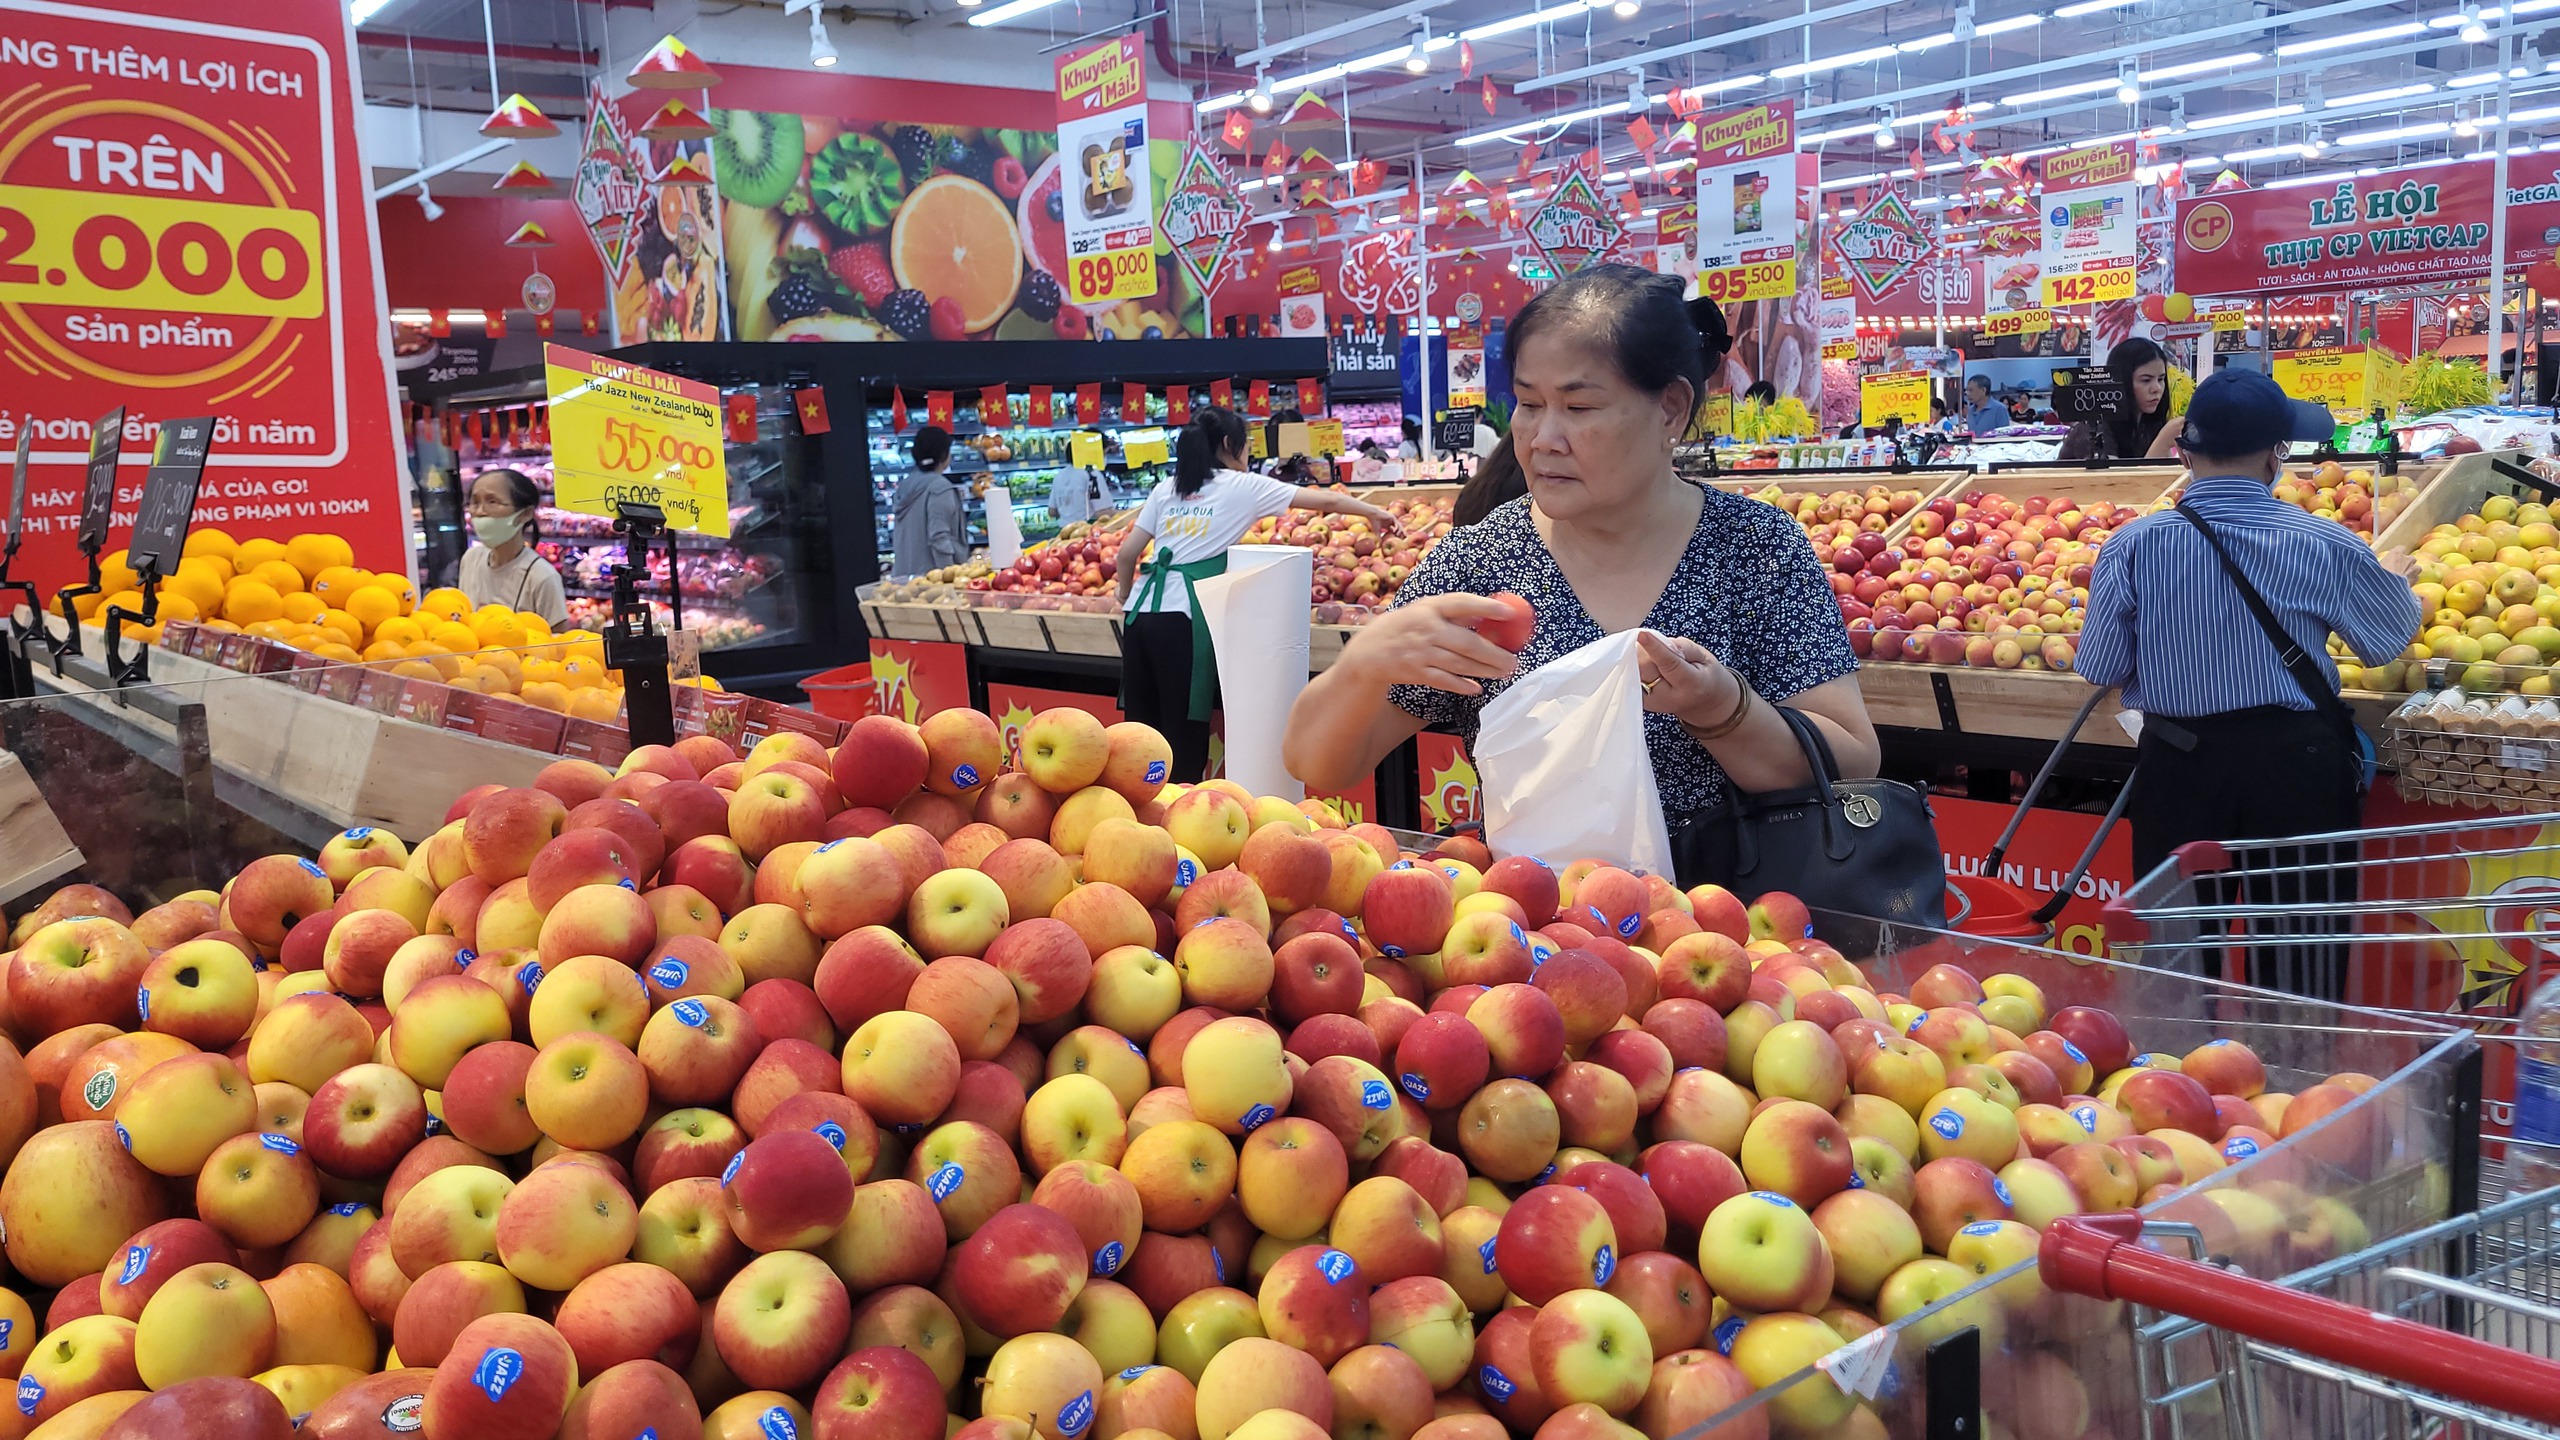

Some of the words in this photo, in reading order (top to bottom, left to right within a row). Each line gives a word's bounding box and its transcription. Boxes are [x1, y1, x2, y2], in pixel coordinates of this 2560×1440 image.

[0, 36, 58, 68] NG
[67, 44, 169, 82] THÊM
[179, 59, 236, 93] LỢI
[246, 61, 303, 98] ÍCH
[1064, 51, 1118, 92] Khuyến
[1705, 112, 1764, 144] Khuyến
[52, 134, 225, 195] TRÊN
[2050, 148, 2108, 175] Khuyến
[2310, 184, 2356, 227] LỄ
[2366, 181, 2440, 225] HỘI
[2506, 185, 2560, 204] ietGA
[1560, 216, 1611, 252] VIỆT
[2190, 216, 2226, 239] CP
[1869, 232, 1922, 262] VIỆT
[2265, 238, 2323, 269] THỊT
[2329, 231, 2362, 259] CP
[2369, 223, 2488, 256] VIETGAP
[2515, 250, 2537, 259] TQC
[1079, 252, 1148, 298] 89.000
[1708, 264, 1785, 301] 95.500
[2257, 273, 2283, 287] TƯƠI
[2291, 271, 2314, 286] SẠCH
[2324, 269, 2338, 280] AN
[2341, 265, 2370, 279] TOÀN
[2377, 257, 2414, 275] KHÔNG
[2417, 255, 2445, 270] CHẤT
[2448, 256, 2469, 269] TẠO
[1922, 270, 1970, 299] Sshi
[2052, 271, 2131, 302] 142.000
[65, 314, 130, 344] Sản
[140, 317, 232, 349] phẩm
[1988, 311, 2049, 334] 499.000
[1336, 350, 1362, 371] hải
[1367, 350, 1395, 371] sản
[2295, 349, 2327, 358] KHUYẾN
[591, 360, 652, 388] KHUYẾN
[655, 376, 681, 394] MÃI
[2295, 372, 2362, 393] 55.000
[584, 378, 602, 392] Táo
[605, 385, 627, 398] Jazz
[630, 390, 651, 404] New
[654, 396, 691, 413] Zealand
[2074, 389, 2123, 411] 89.000
[122, 413, 161, 441] ến
[250, 418, 316, 445] năm
[597, 416, 715, 472] 55.000
[31, 488, 76, 508] HÃY
[224, 478, 265, 497] CỦA
[273, 479, 309, 495] GO!
[234, 502, 291, 521] PHẠM
[295, 502, 316, 517] VI
[320, 498, 370, 516] 10KM
[959, 769, 978, 785] JAZZ
[1146, 769, 1165, 781] JAZZ
[1181, 862, 1192, 886] JAZZ
[1624, 914, 1639, 933] JAZZ
[653, 967, 681, 981] JAZZ
[672, 1003, 698, 1020] JAZZ
[1366, 1091, 1388, 1104] JAZZ
[1405, 1079, 1427, 1094] JAZZ
[1931, 1117, 1957, 1131] JAZZ
[935, 1167, 955, 1198] JAZZ
[126, 1250, 140, 1276] JAZZ
[1107, 1248, 1117, 1271] JAZZ
[1329, 1255, 1346, 1281] JAZZ
[1598, 1249, 1609, 1279] JAZZ
[491, 1356, 509, 1395] JAZZ
[1484, 1374, 1510, 1392] JAZZ
[18, 1386, 41, 1400] JAZZ
[391, 1404, 421, 1416] ckMee!
[1067, 1395, 1091, 1428] JAZZ
